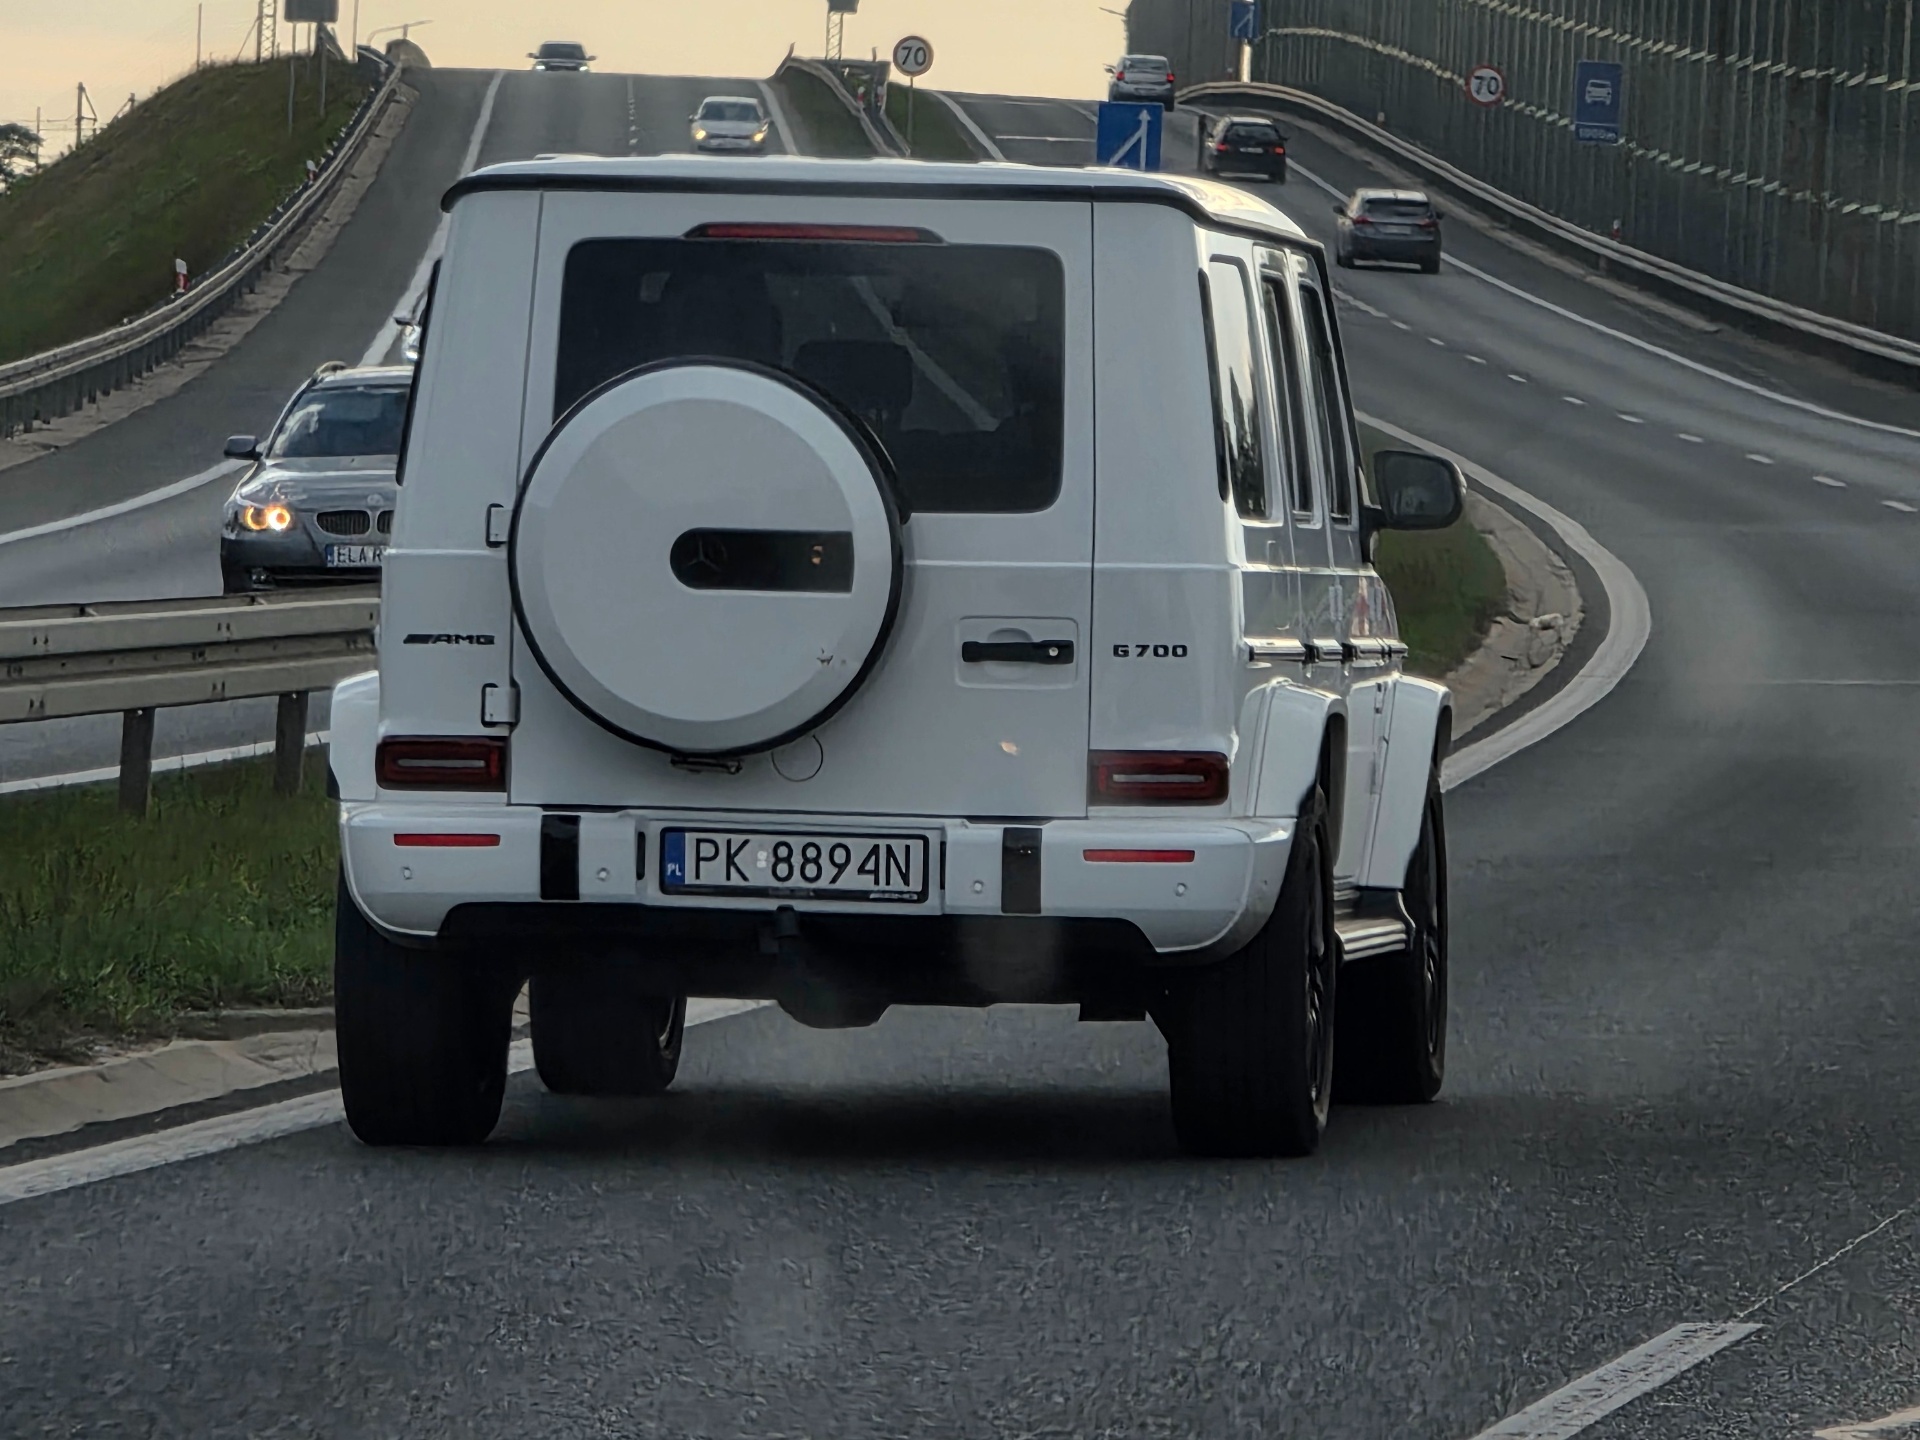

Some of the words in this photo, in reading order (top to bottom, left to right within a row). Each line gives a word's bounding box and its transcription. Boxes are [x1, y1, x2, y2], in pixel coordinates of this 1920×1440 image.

[901, 46, 927, 67] 70
[1474, 75, 1499, 95] 70
[431, 633, 495, 645] AMG
[1113, 644, 1130, 658] G
[1135, 644, 1188, 658] 700
[667, 862, 682, 876] PL
[695, 837, 751, 882] PK
[771, 840, 911, 887] 8894N
